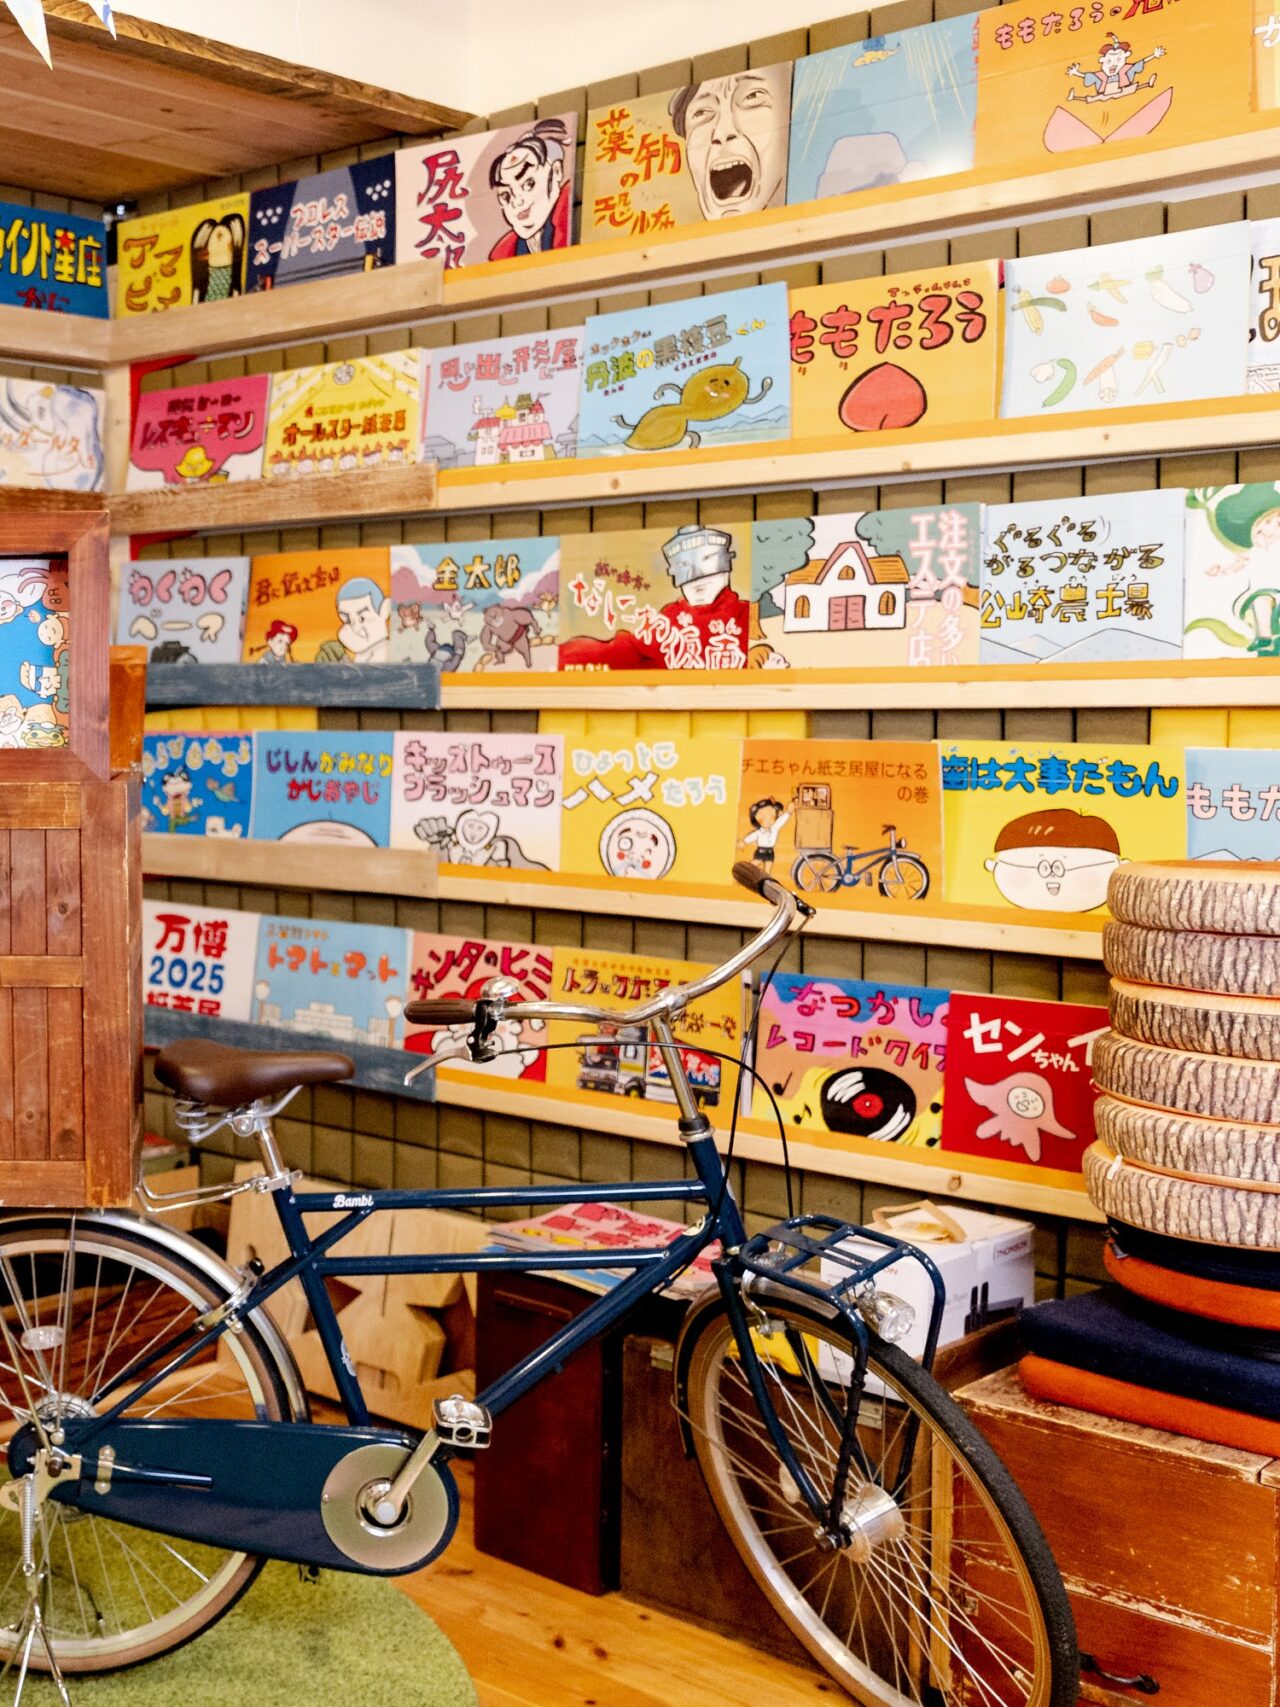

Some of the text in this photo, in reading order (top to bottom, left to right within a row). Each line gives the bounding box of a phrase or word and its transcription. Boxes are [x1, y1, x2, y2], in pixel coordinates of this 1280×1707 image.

[289, 192, 350, 232] プロレス
[253, 209, 387, 266] スーパースター伝説
[789, 289, 988, 365] ももたろう
[431, 553, 521, 592] 金太郎
[403, 740, 557, 776] キッズトゥース
[572, 741, 679, 776] ひょっとこ
[741, 758, 928, 780] チエちゃん紙芝居屋になる
[942, 754, 1179, 799] 歯は大事だもん
[403, 773, 556, 808] ブラッシュマン
[896, 785, 930, 804] の巻
[155, 914, 229, 959] 万博
[148, 954, 225, 995] 2025
[789, 981, 947, 1028] なつかし
[1031, 1048, 1080, 1073] ちゃん
